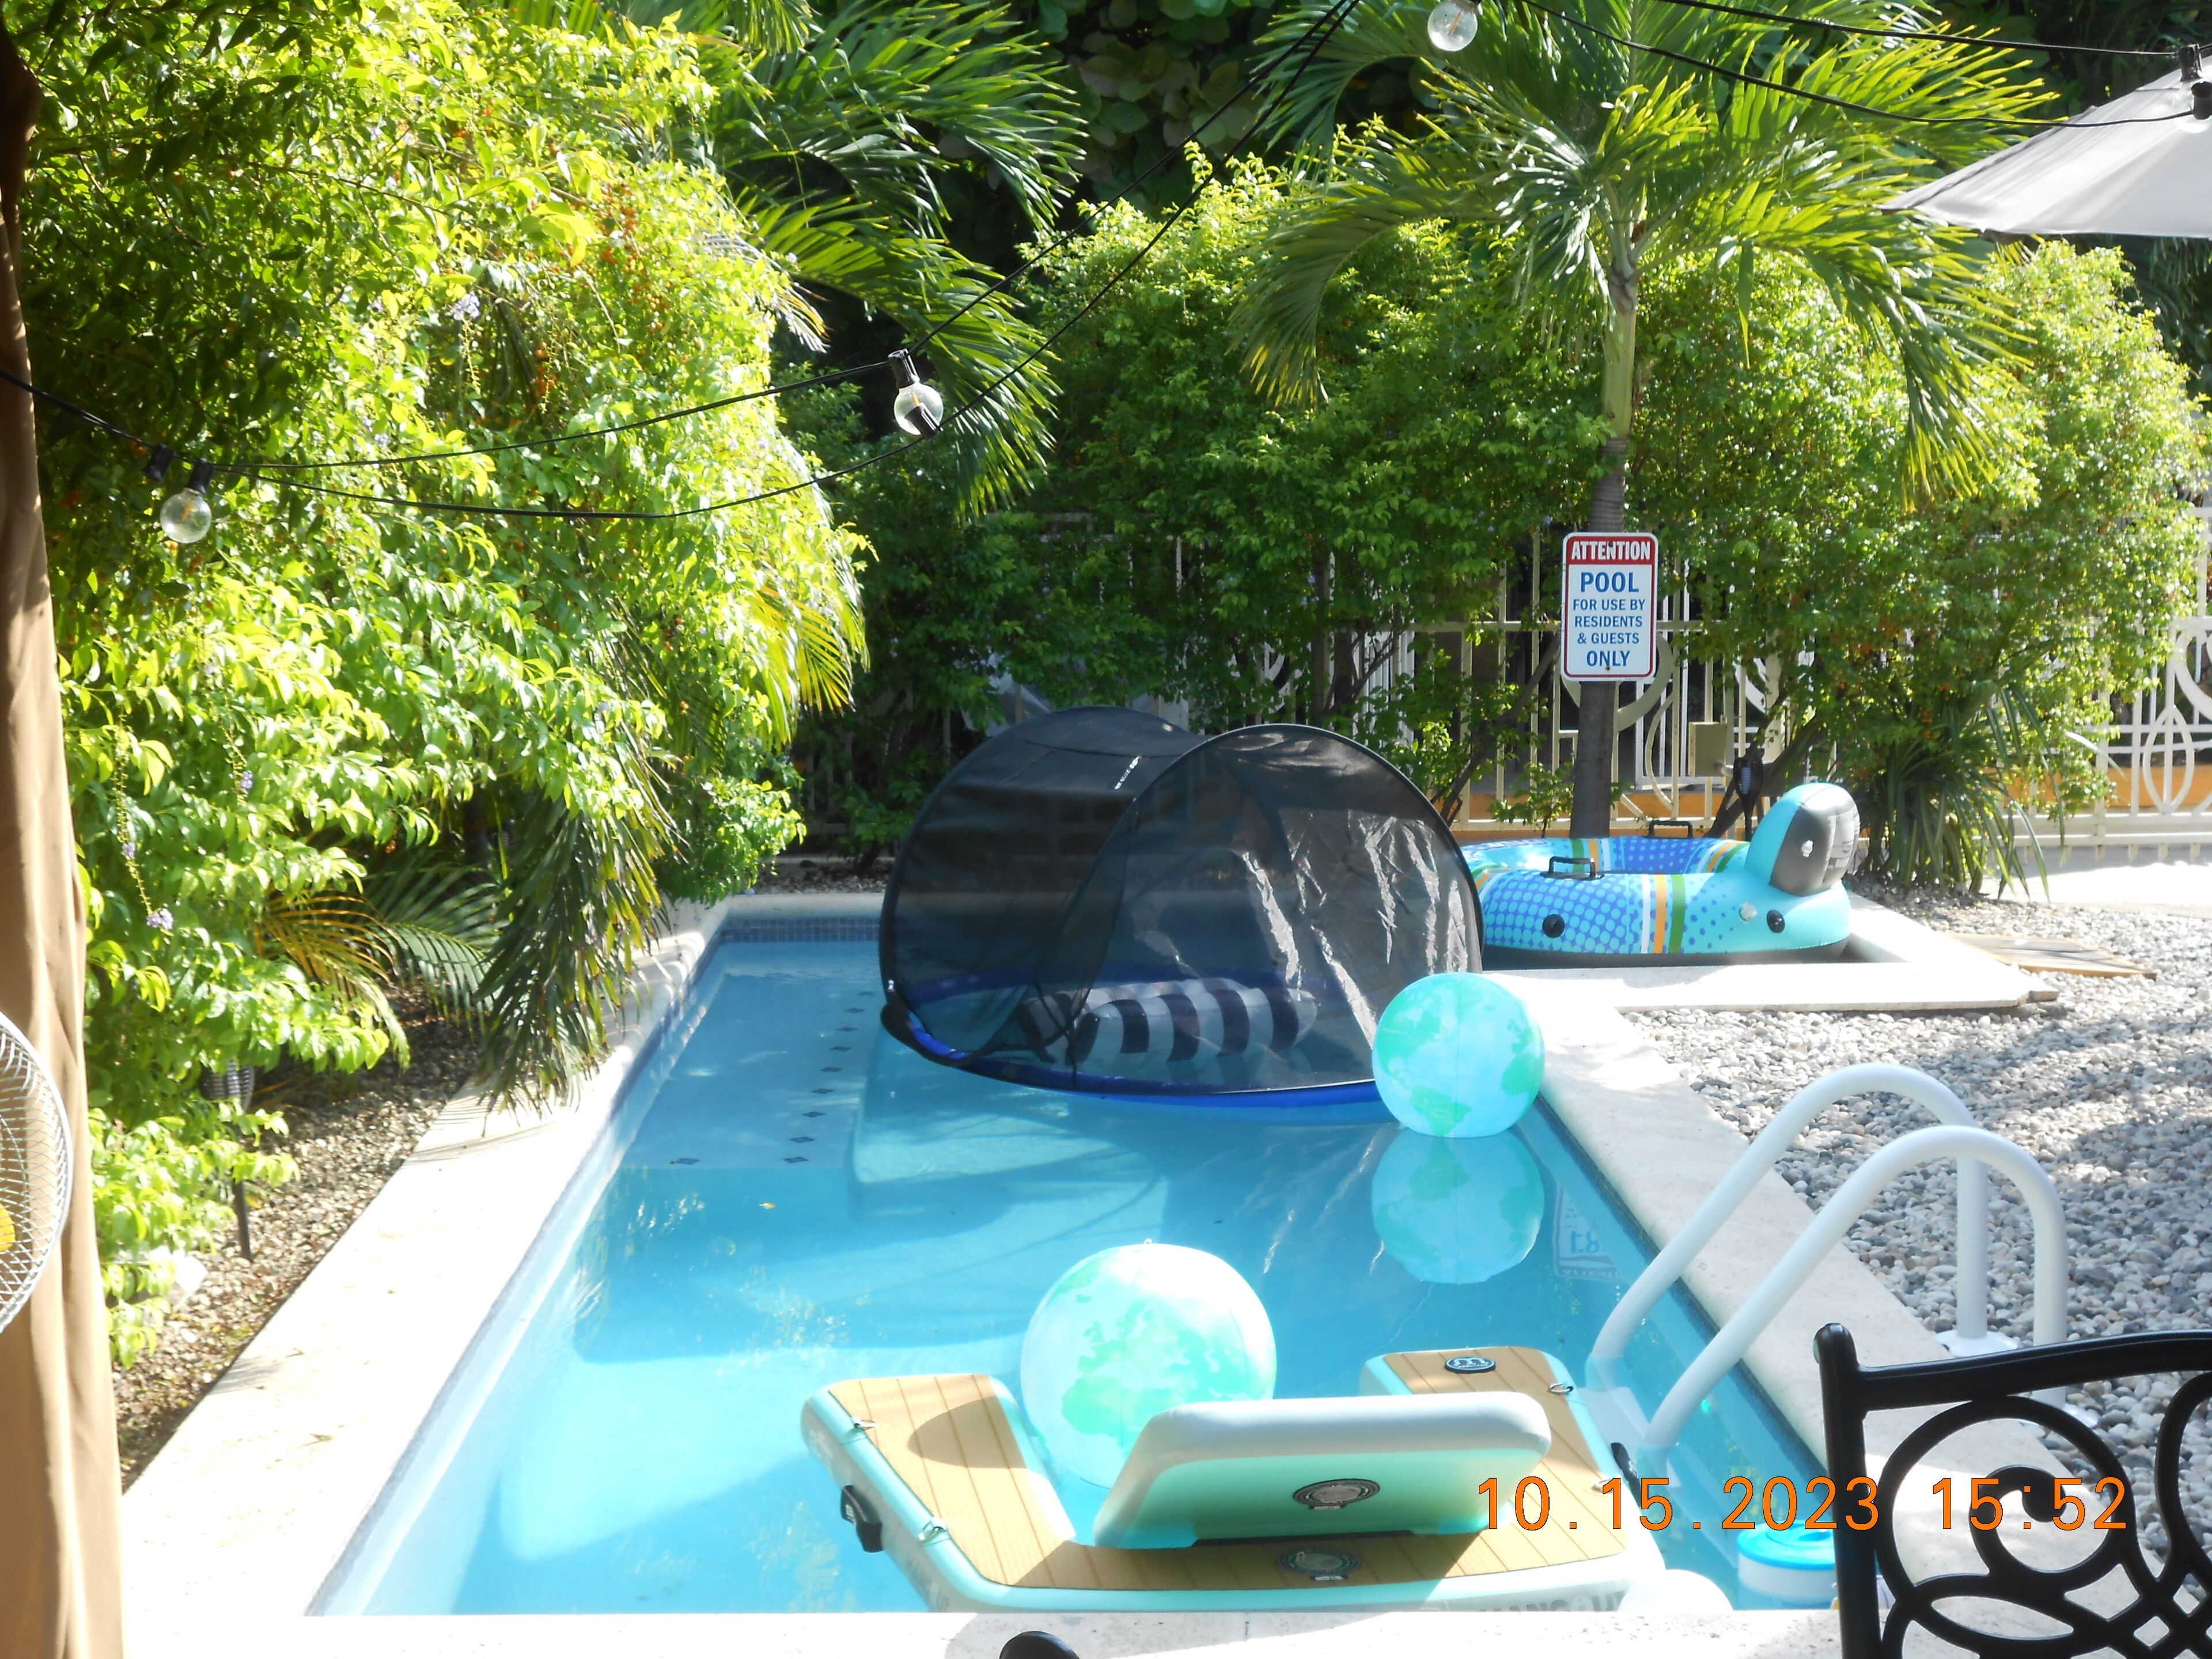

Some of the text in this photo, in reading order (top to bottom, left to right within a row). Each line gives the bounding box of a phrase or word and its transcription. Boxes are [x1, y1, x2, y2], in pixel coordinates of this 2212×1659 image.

[1571, 541, 1650, 560] ATTENTION
[1580, 571, 1639, 593] POOL
[1573, 599, 1646, 611] FOR USE BY
[1574, 616, 1643, 627] RESIDENTS
[1577, 632, 1639, 644] & GUESTS
[1586, 650, 1631, 667] ONLY
